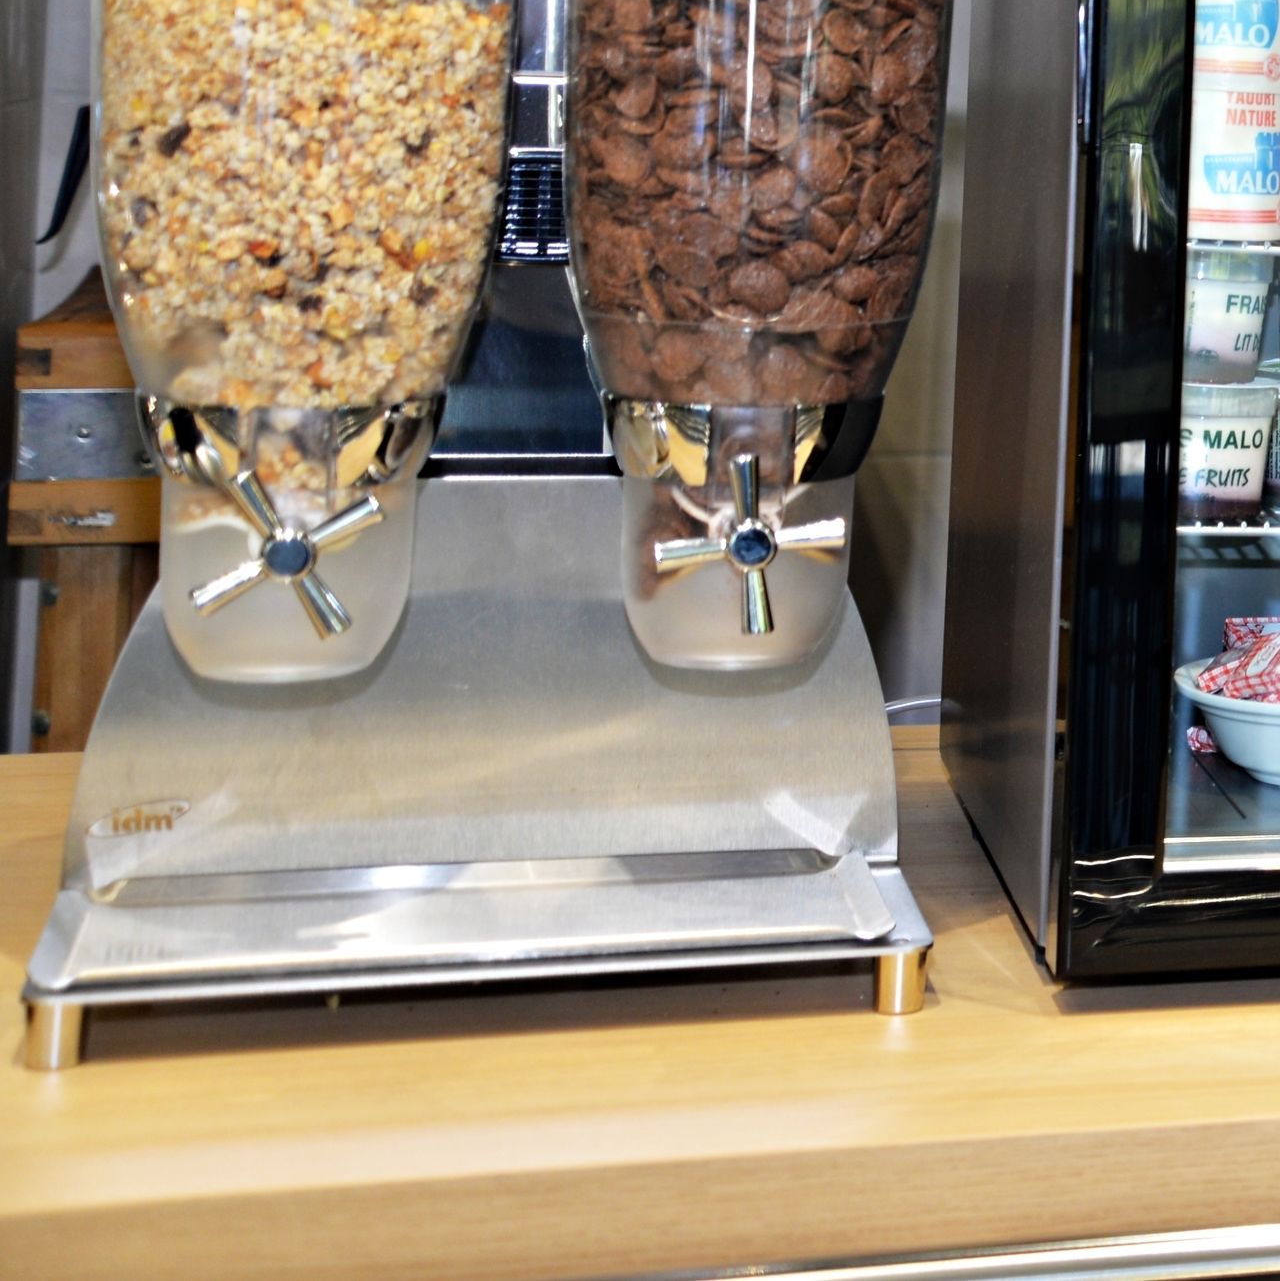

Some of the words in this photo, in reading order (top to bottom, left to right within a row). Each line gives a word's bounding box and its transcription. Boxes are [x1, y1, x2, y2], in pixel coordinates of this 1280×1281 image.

[1226, 108, 1277, 128] NATURE
[1215, 170, 1280, 195] MALO
[1203, 428, 1264, 450] MALO
[1194, 467, 1250, 488] FRUITS
